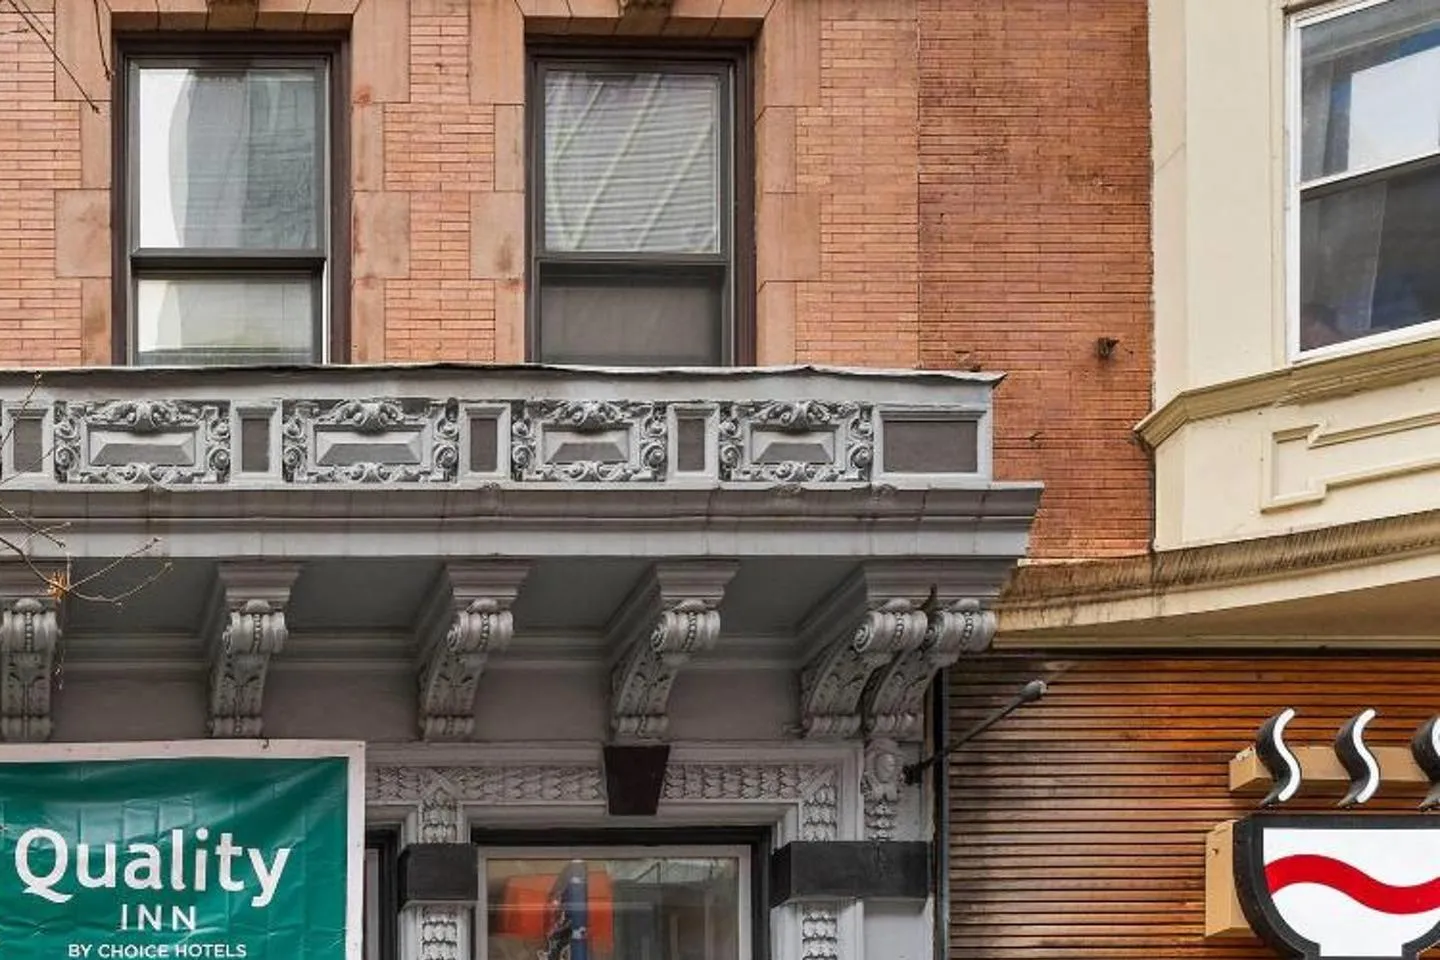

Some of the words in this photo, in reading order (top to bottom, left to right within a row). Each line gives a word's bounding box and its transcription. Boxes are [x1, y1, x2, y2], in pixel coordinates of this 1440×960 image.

[15, 827, 291, 907] Quality
[120, 903, 196, 931] INN
[68, 944, 92, 957] BY
[98, 944, 169, 958] CHOICE
[176, 944, 247, 958] HOTELS
